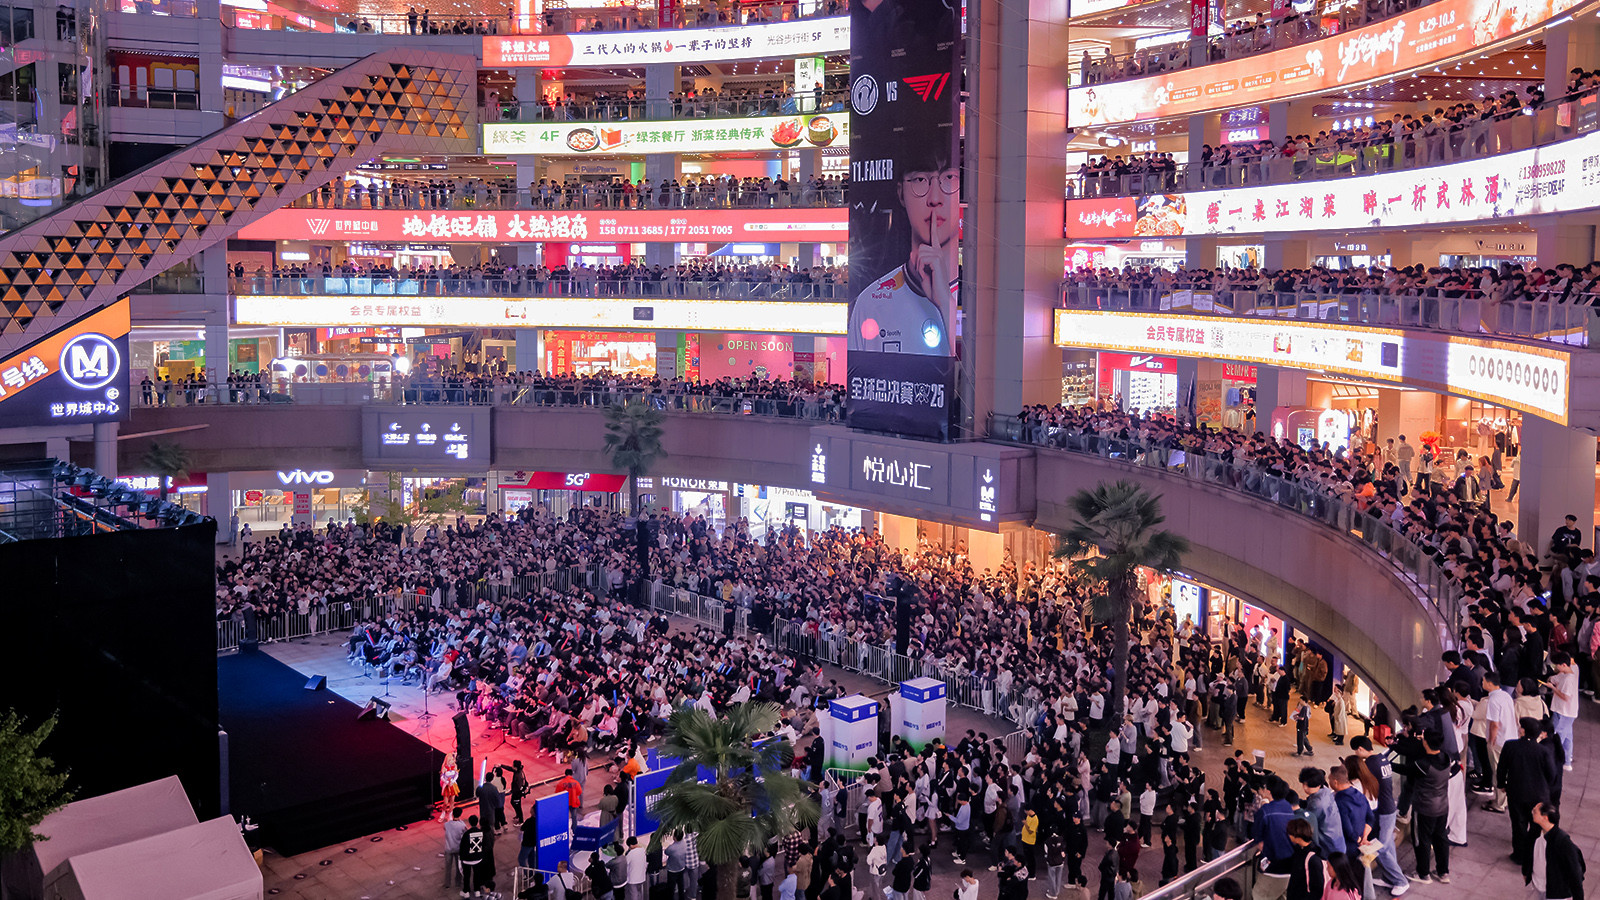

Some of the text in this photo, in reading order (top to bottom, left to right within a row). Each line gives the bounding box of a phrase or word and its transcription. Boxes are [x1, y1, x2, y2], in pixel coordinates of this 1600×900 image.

[811, 31, 822, 42] 5F
[885, 81, 898, 102] VS
[539, 130, 560, 142] 4F
[636, 127, 765, 143] 绿茶餐厅 浙菜经典传承
[852, 159, 893, 182] T1.FAKER
[402, 213, 588, 239] 地铁旺铺 火热招商
[599, 226, 616, 235] 158
[617, 226, 640, 235] 0711
[641, 226, 664, 235] 3685
[670, 226, 686, 235] 177
[688, 226, 710, 235] 2051
[711, 226, 733, 235] 7005
[350, 305, 422, 317] 会员专属权益
[1146, 325, 1205, 345] 会员专属权益
[727, 339, 793, 352] OPEN SOON
[851, 377, 945, 409] 全球总决赛 25
[51, 401, 120, 416] 世界城中心
[278, 469, 334, 484] vivo
[863, 455, 933, 491] 悦心汇
[661, 476, 706, 489] HONOR
